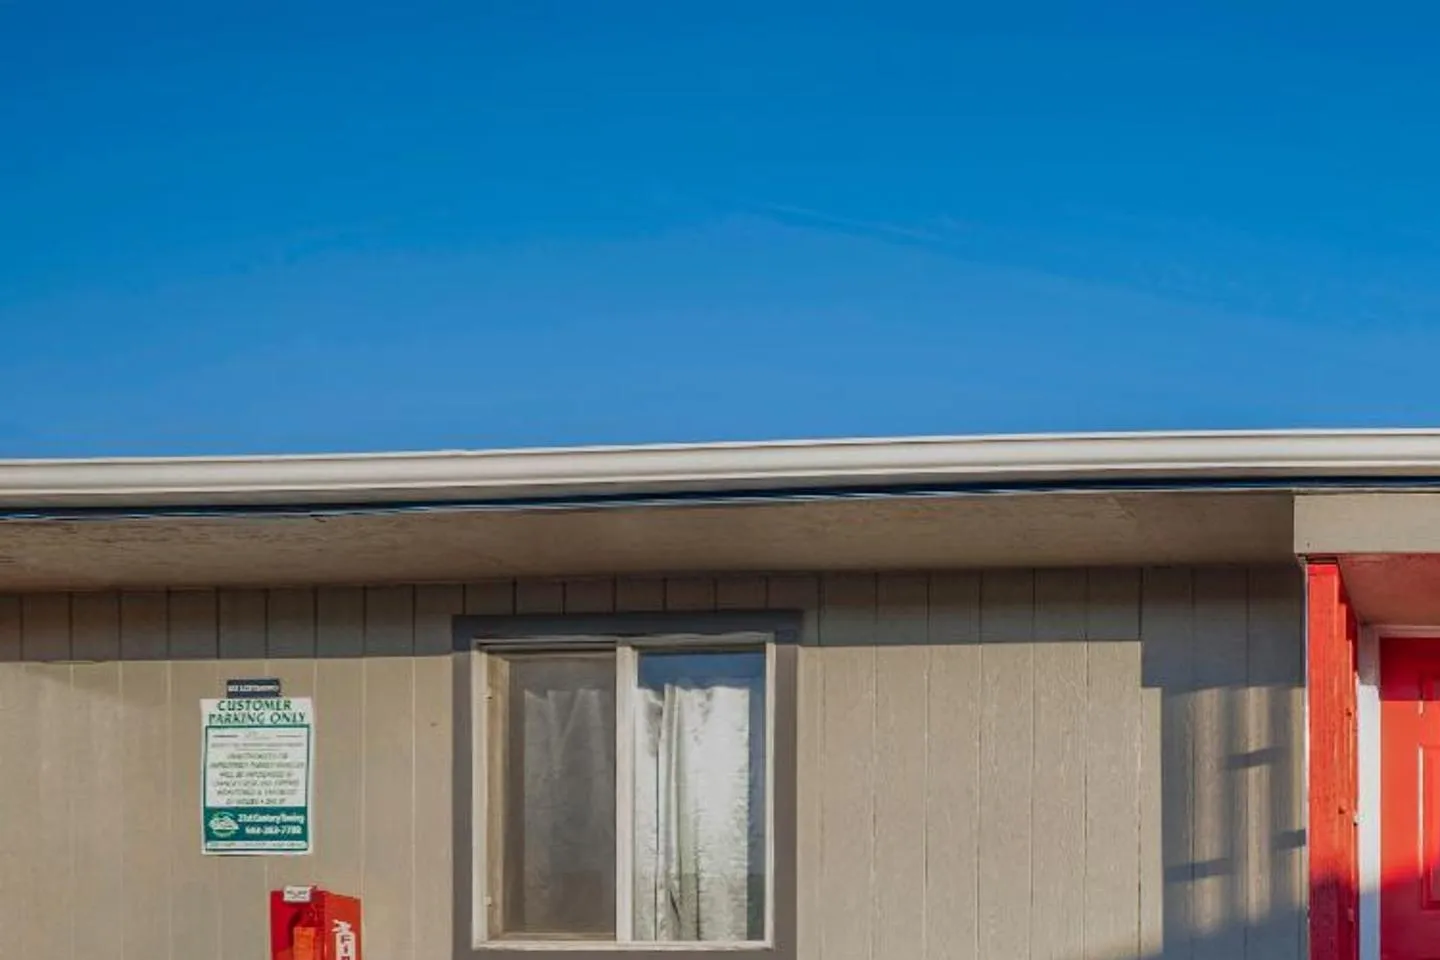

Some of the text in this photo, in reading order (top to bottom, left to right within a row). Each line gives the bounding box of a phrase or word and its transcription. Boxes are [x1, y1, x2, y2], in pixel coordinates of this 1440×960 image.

[216, 700, 292, 711] CUSTOMER
[208, 712, 305, 725] PARKING ONLY
